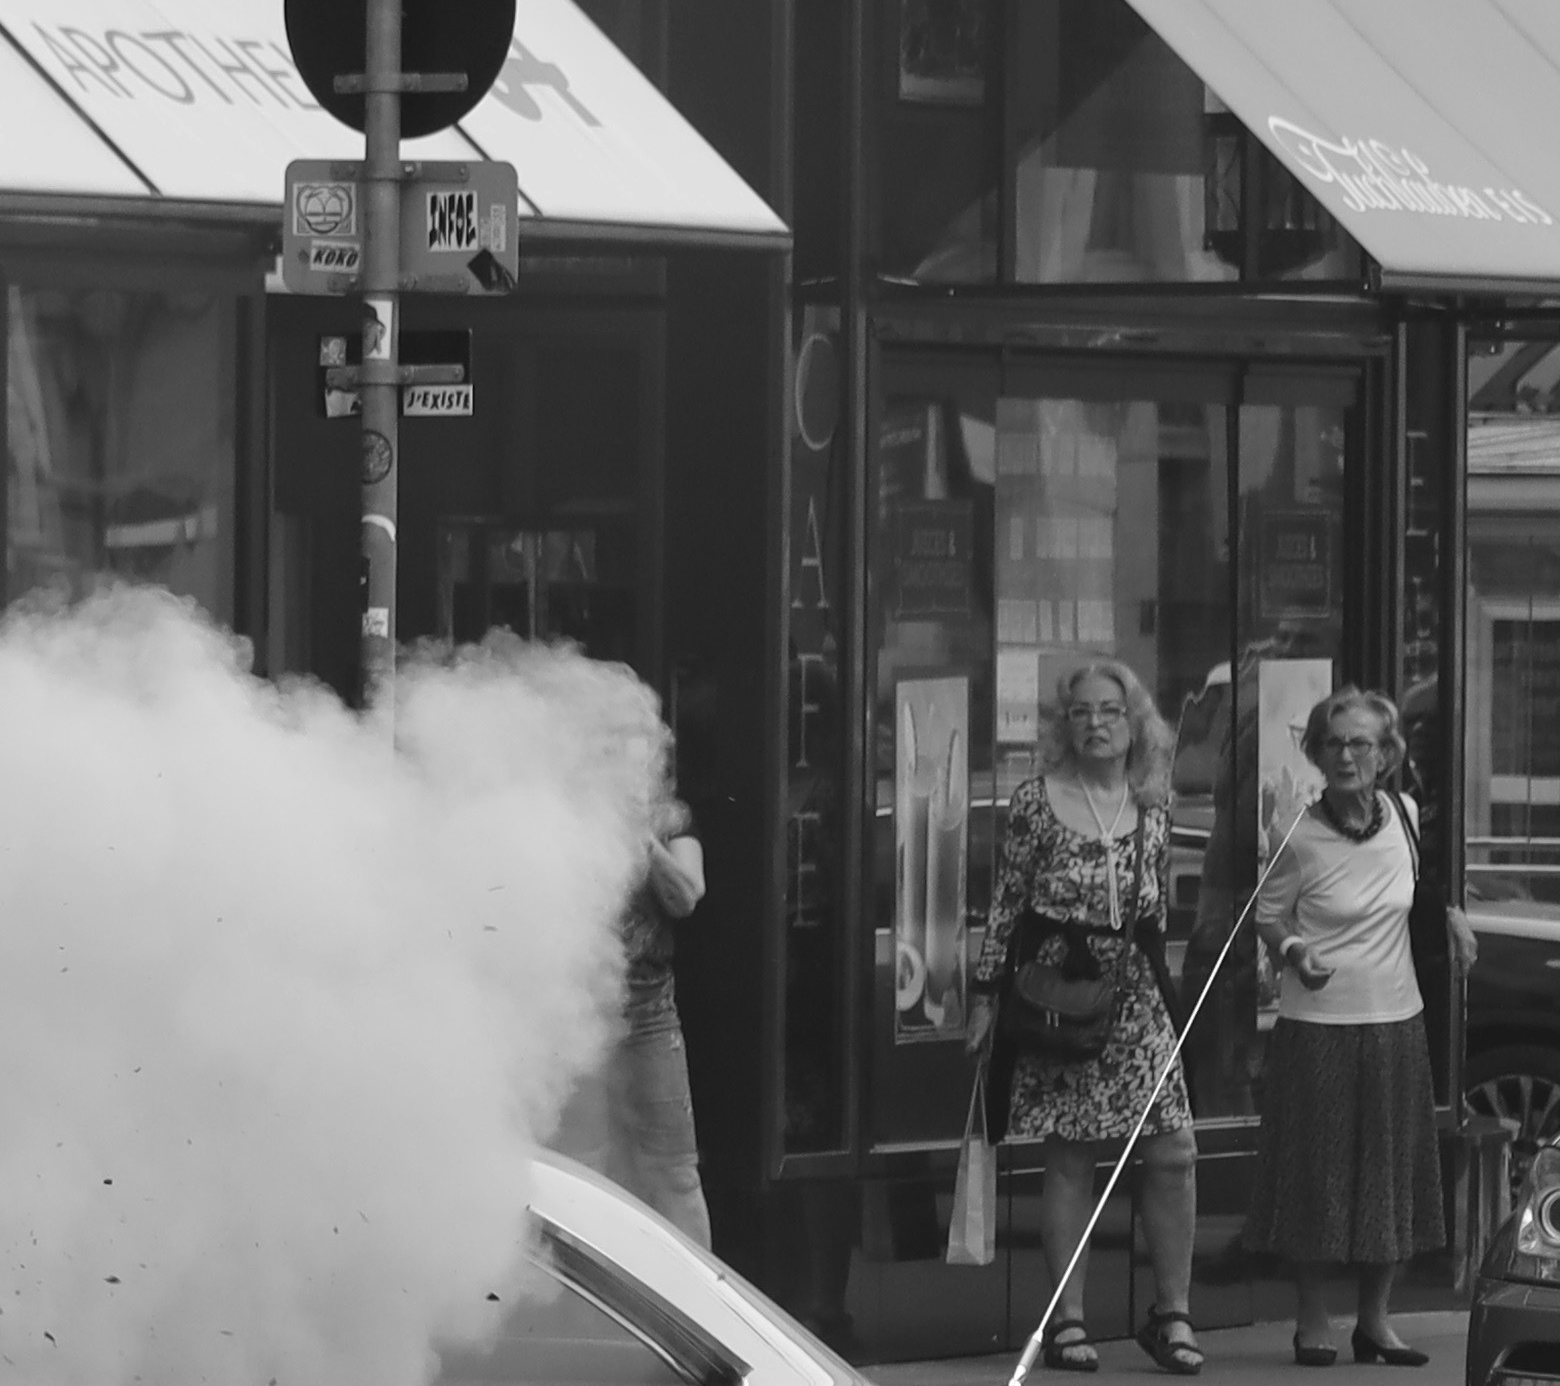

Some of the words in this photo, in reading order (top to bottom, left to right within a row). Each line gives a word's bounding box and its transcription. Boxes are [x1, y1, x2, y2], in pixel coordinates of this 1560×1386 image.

[30, 20, 323, 113] APOTHE
[312, 248, 359, 268] KOKO
[407, 390, 470, 410] J'EXISTE
